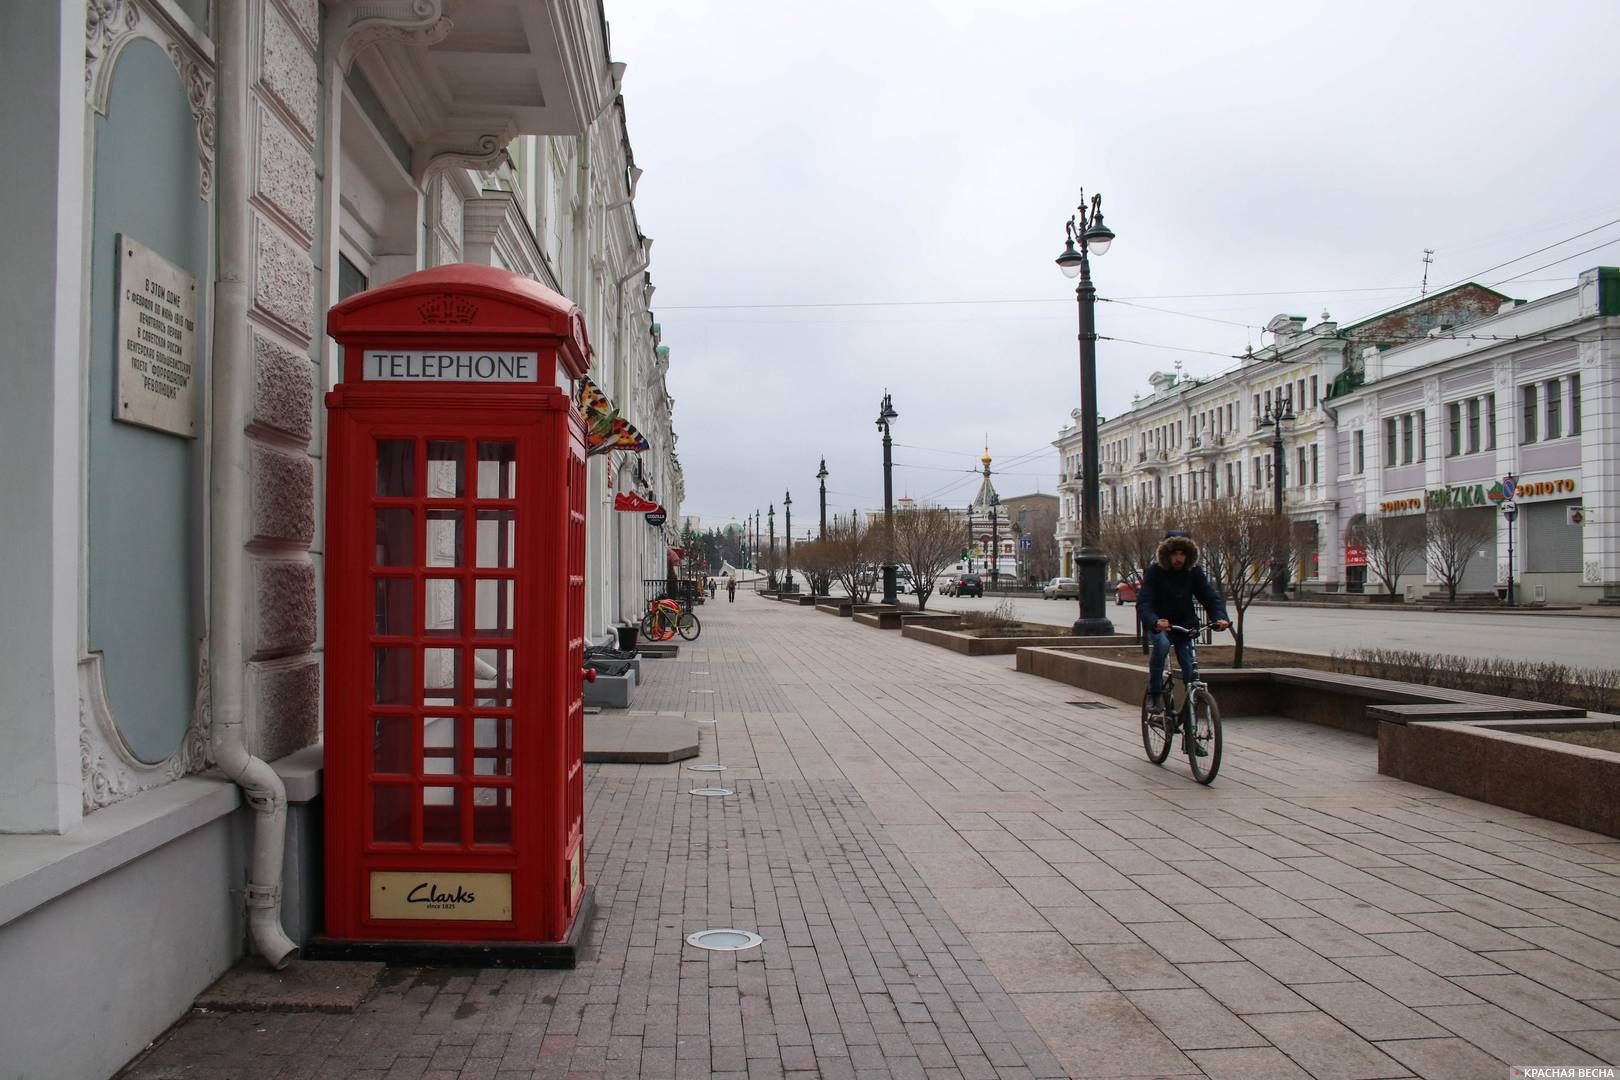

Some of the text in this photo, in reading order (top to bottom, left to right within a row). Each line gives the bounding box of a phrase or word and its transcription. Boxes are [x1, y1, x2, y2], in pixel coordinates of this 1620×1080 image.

[150, 282, 165, 300] ЭТОМ
[166, 290, 181, 308] ДОМЕ
[373, 354, 528, 379] TELEPHONE
[407, 882, 475, 903] Clarks
